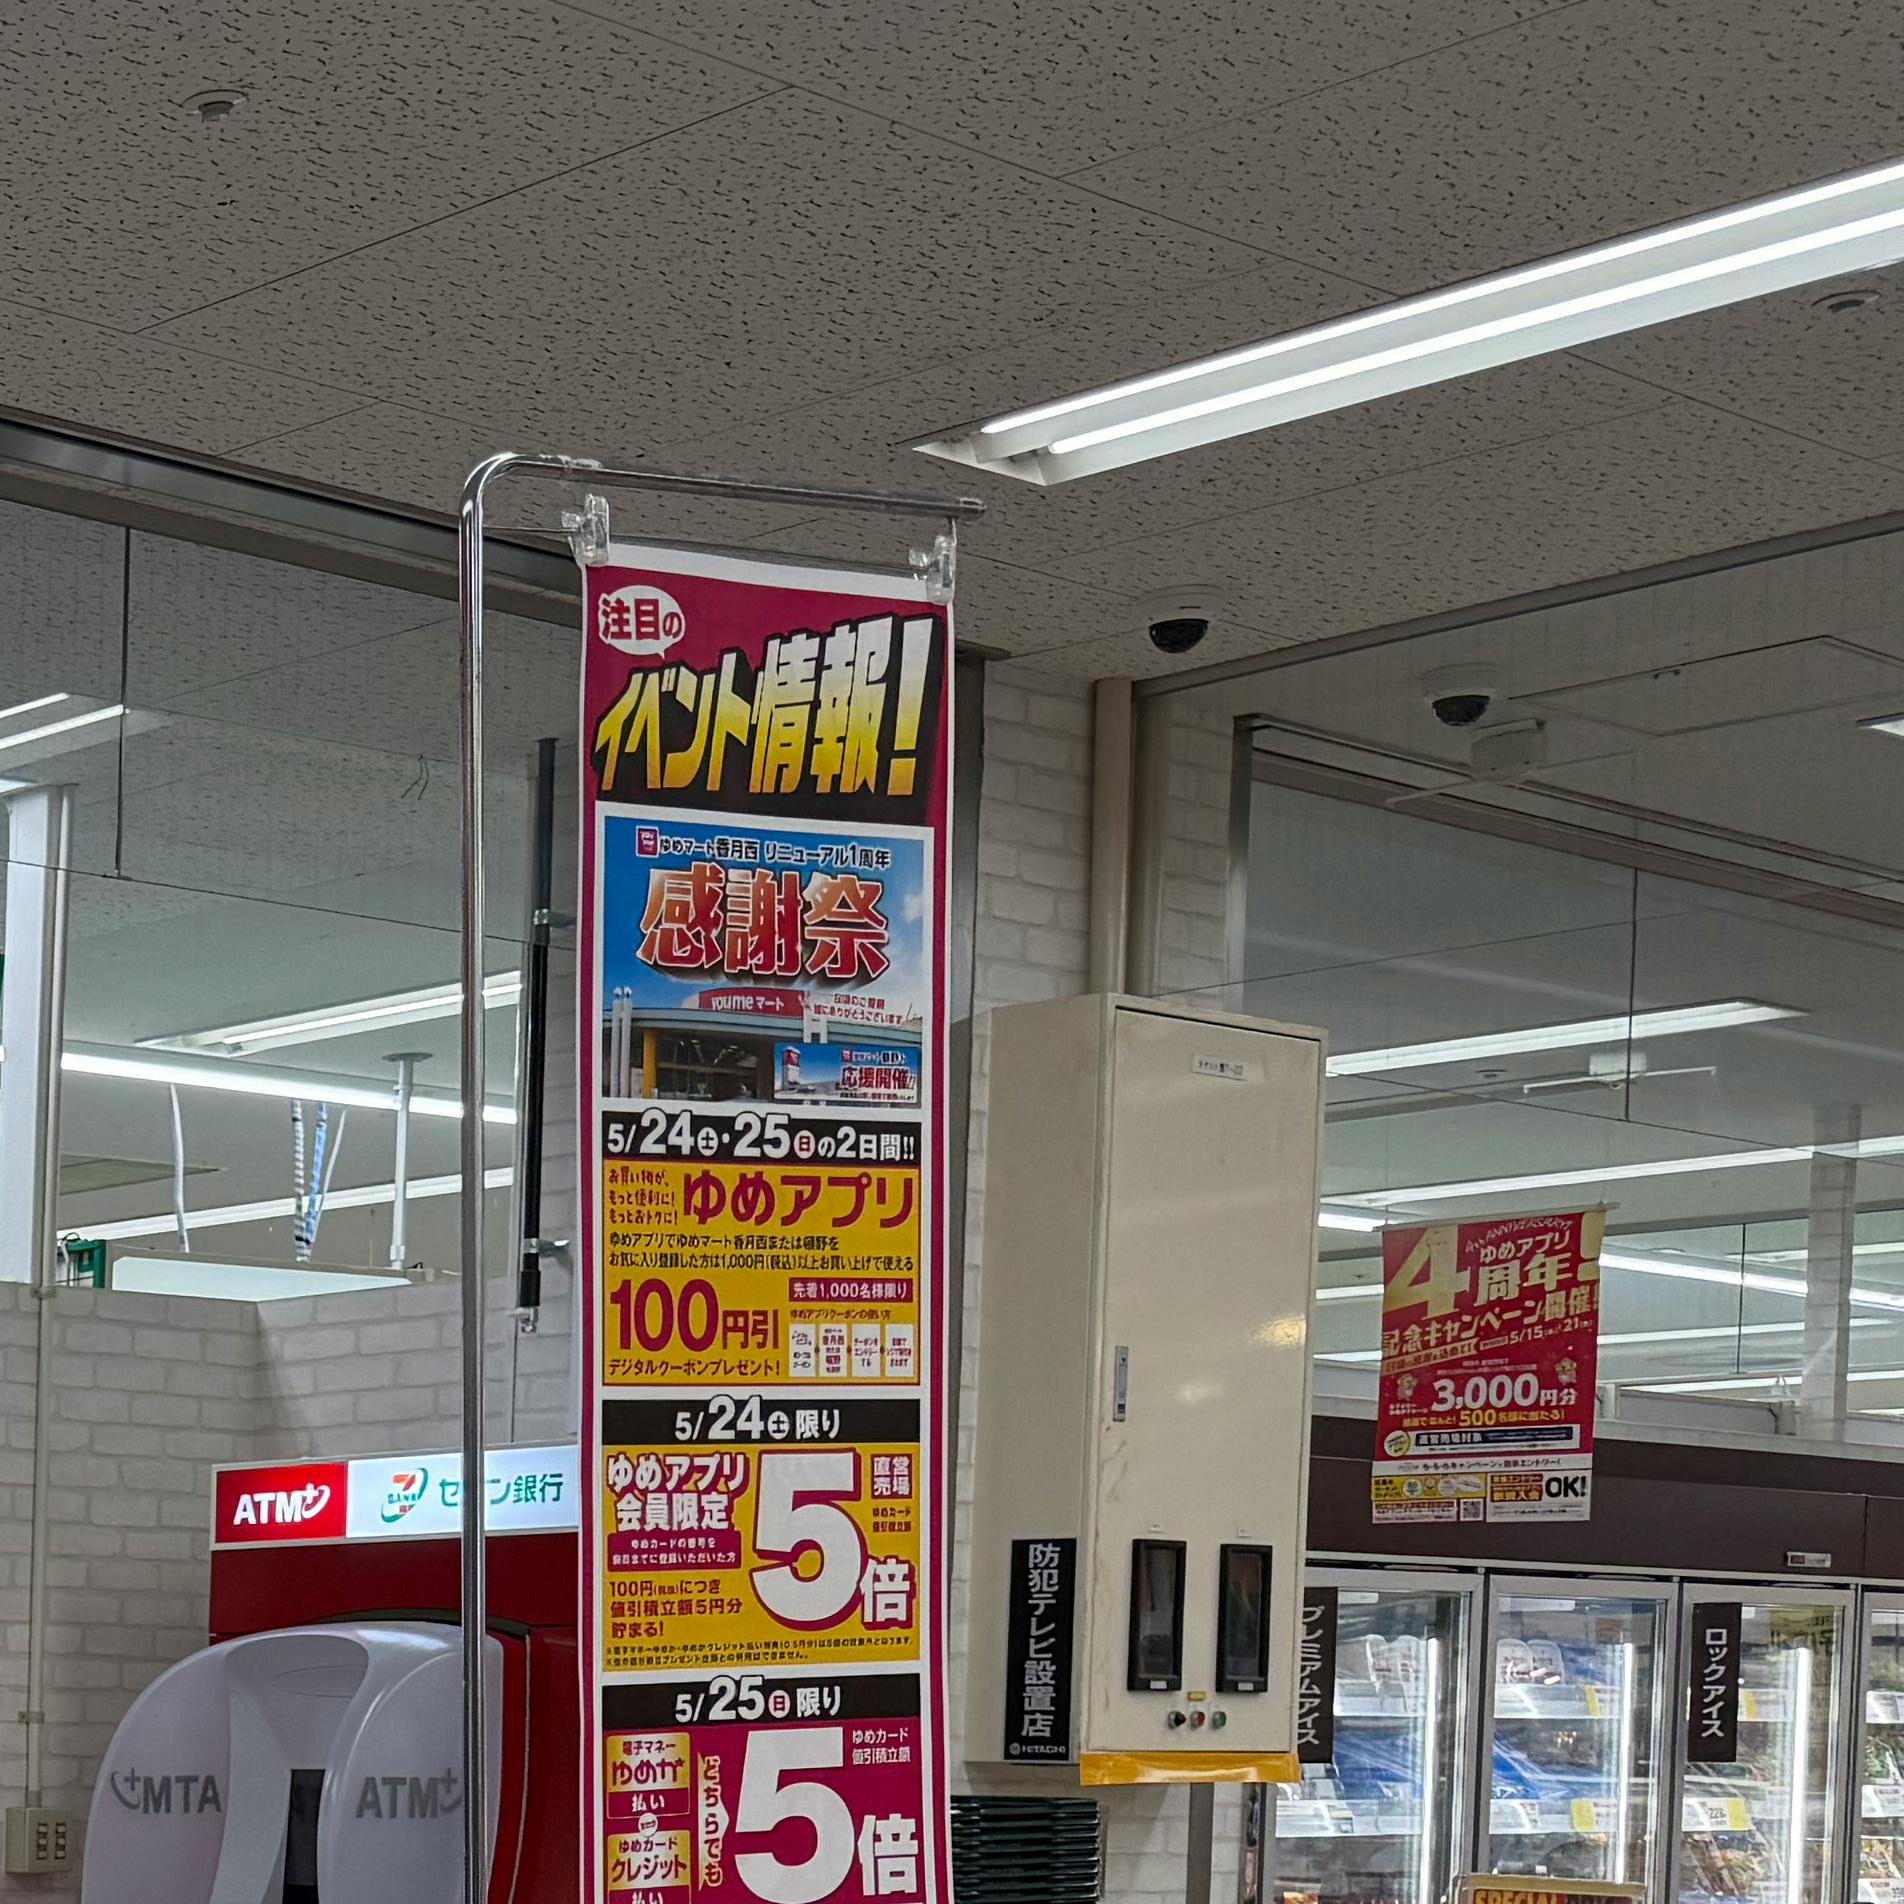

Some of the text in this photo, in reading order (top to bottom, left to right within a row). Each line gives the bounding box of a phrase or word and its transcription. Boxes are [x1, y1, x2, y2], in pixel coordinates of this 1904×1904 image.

[599, 599, 682, 641] 注目の
[595, 617, 934, 796] イベント情報!
[764, 841, 892, 870] リニューアル1周年
[636, 863, 890, 978] 感謝祭
[683, 1168, 914, 1229] ゆめアプリ
[1479, 1229, 1571, 1264] ゆめアプリ
[609, 1278, 780, 1353] 100円引
[608, 1358, 781, 1378] デジタルクーポンプレゼント!
[438, 1472, 563, 1507] セン銀行
[606, 1452, 747, 1495] ゆめアプリ
[1545, 1475, 1587, 1498] OK!
[615, 1493, 730, 1532] 会員限定
[611, 1621, 665, 1639] 貯まる!
[1021, 1543, 1061, 1738] 防犯テレビ設置店
[1297, 1604, 1326, 1745] プレミアムアイス
[1699, 1627, 1728, 1739] ロックアイス
[852, 1727, 910, 1745] ゆめカード
[1021, 1744, 1066, 1754] HITACHI
[630, 1794, 665, 1813] 払い
[703, 1755, 724, 1888] どちらでも
[618, 1837, 678, 1853] ゆめカード
[611, 1856, 687, 1883] クレジット
